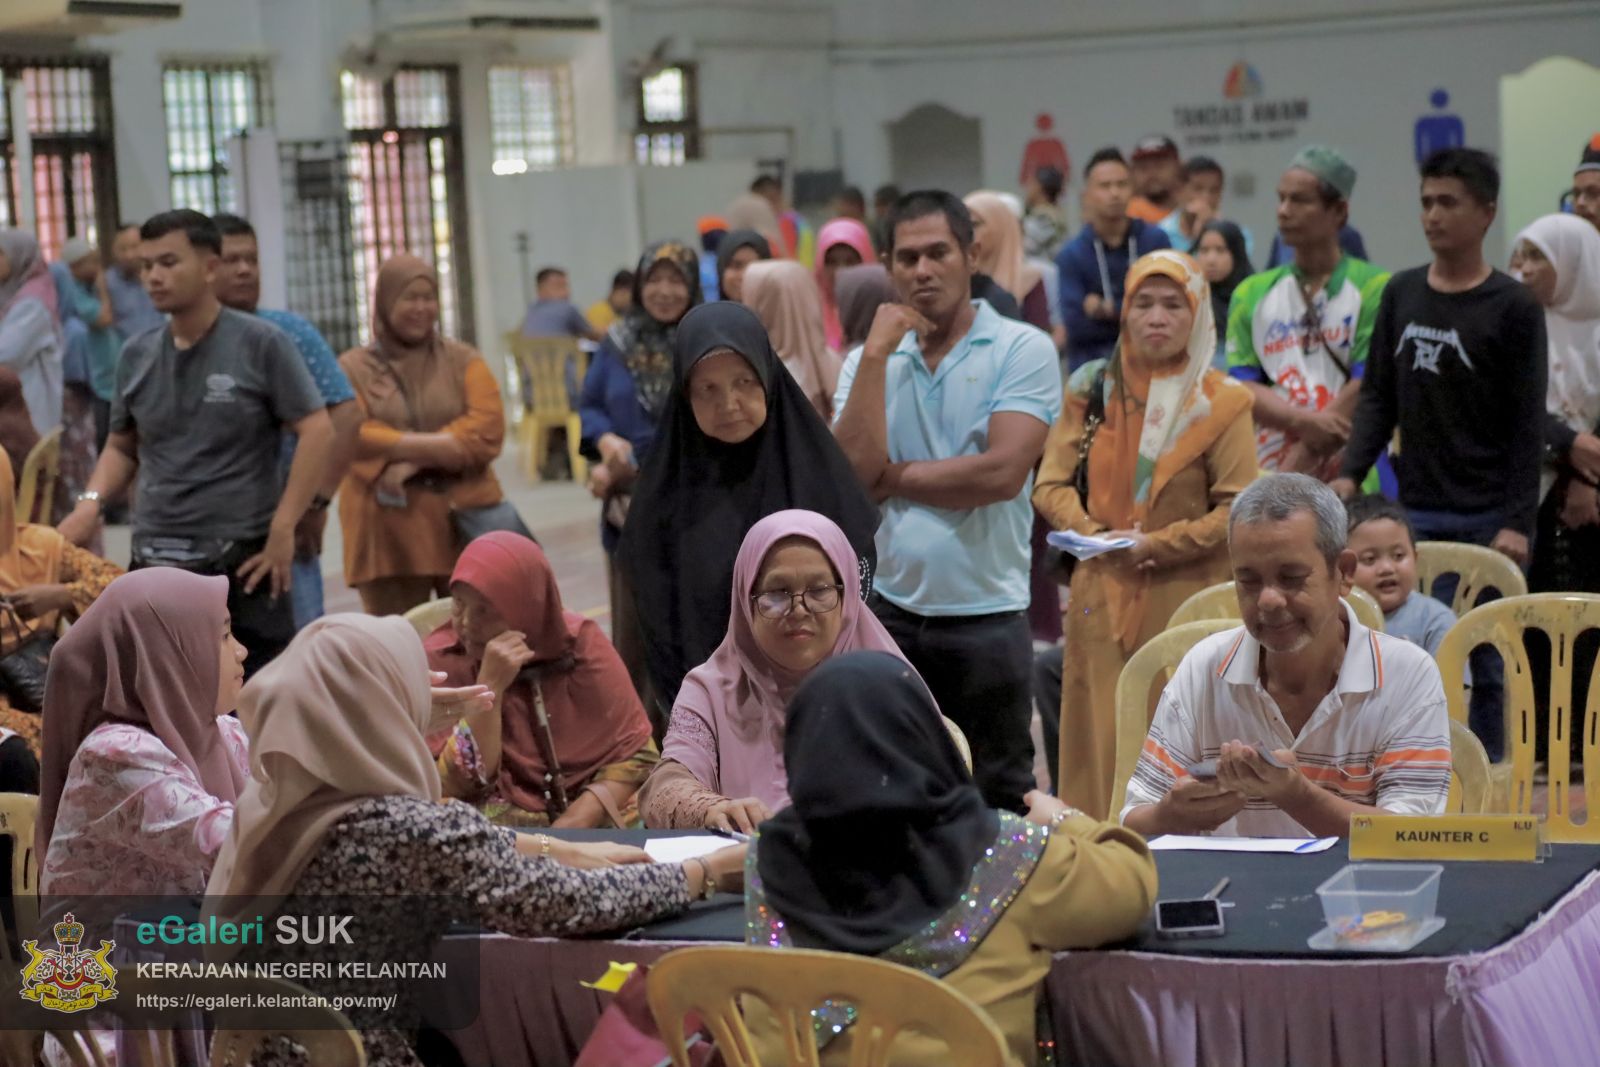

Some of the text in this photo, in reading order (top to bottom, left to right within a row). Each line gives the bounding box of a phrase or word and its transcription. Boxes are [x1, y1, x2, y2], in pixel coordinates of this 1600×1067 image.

[1395, 321, 1474, 369] METALLICA
[1396, 831, 1489, 842] KAUNTER C
